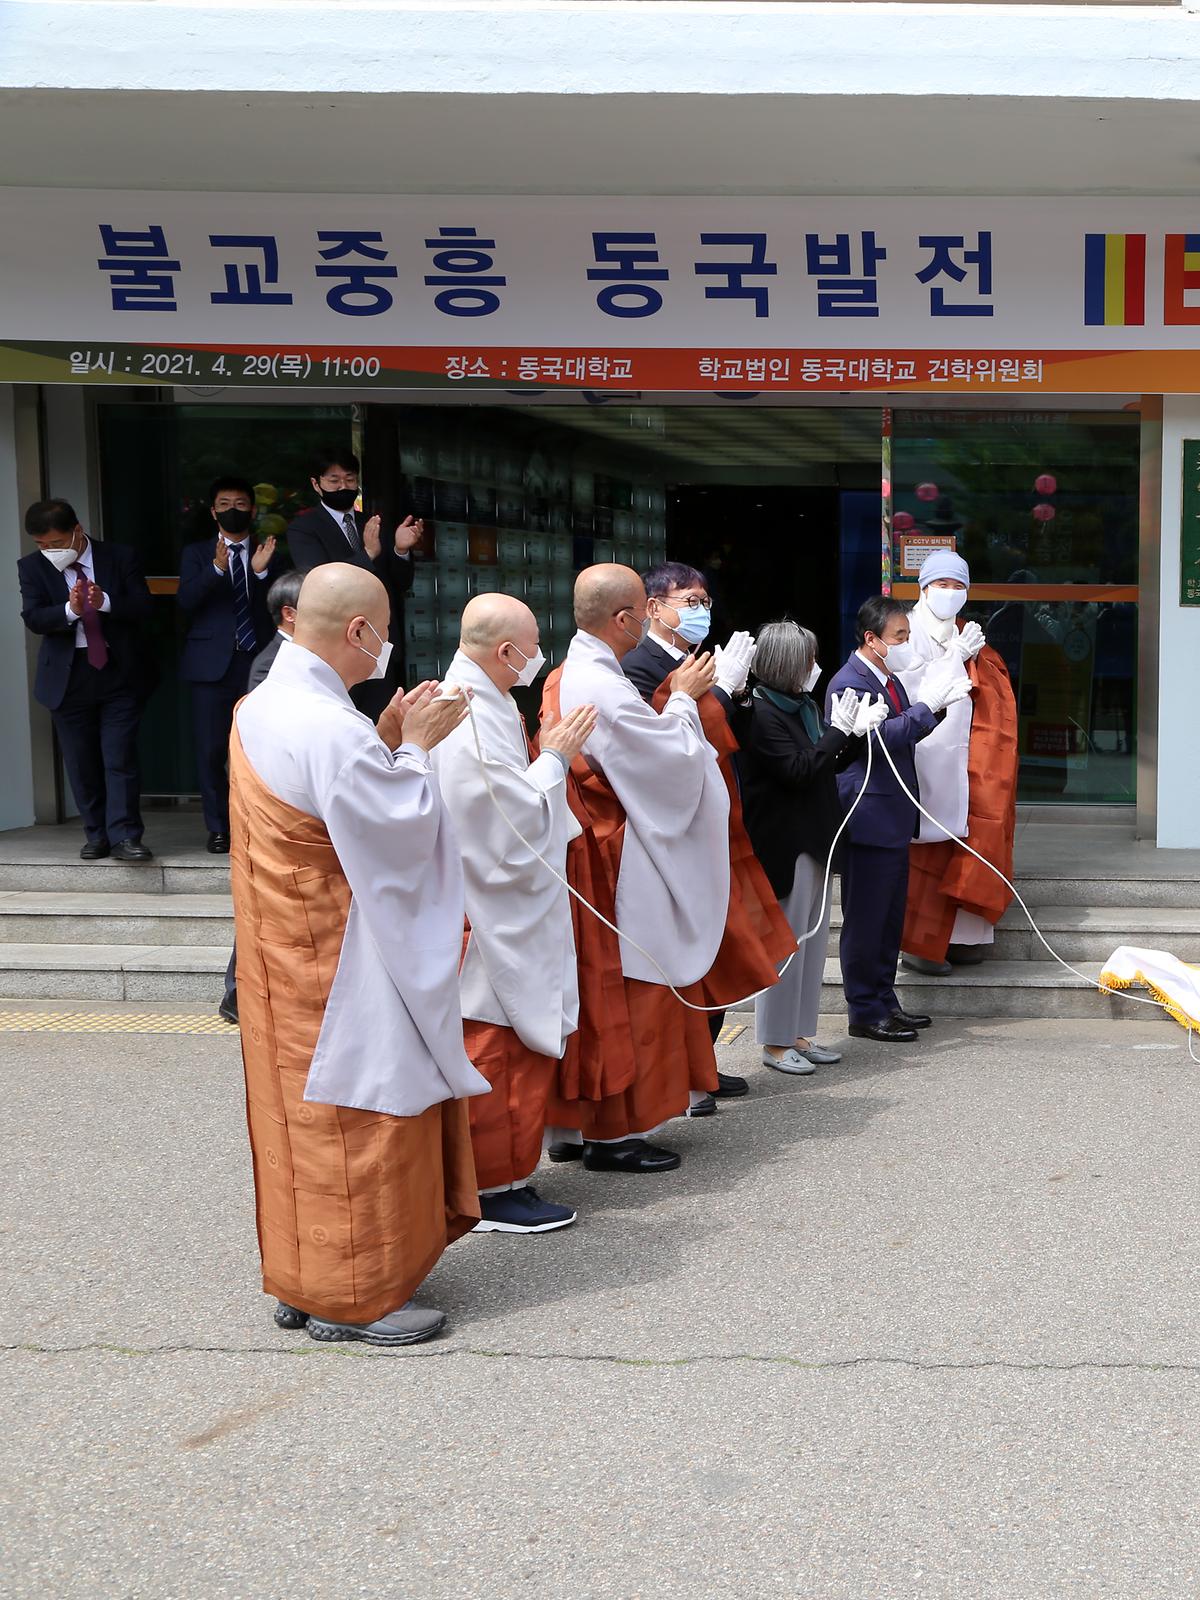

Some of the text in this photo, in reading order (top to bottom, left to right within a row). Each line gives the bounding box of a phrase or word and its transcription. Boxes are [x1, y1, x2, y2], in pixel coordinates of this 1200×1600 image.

[98, 224, 995, 318] 불교중흥 동국발전
[68, 351, 115, 375] 일시
[141, 353, 200, 376] 2021.
[211, 355, 232, 376] 4.
[243, 353, 312, 379] 29(목)
[322, 357, 380, 377] 11:00
[445, 356, 490, 380] 장소
[517, 357, 633, 381] 동국대학교
[698, 358, 1044, 383] 학교법인 동국대학교 건학위원회
